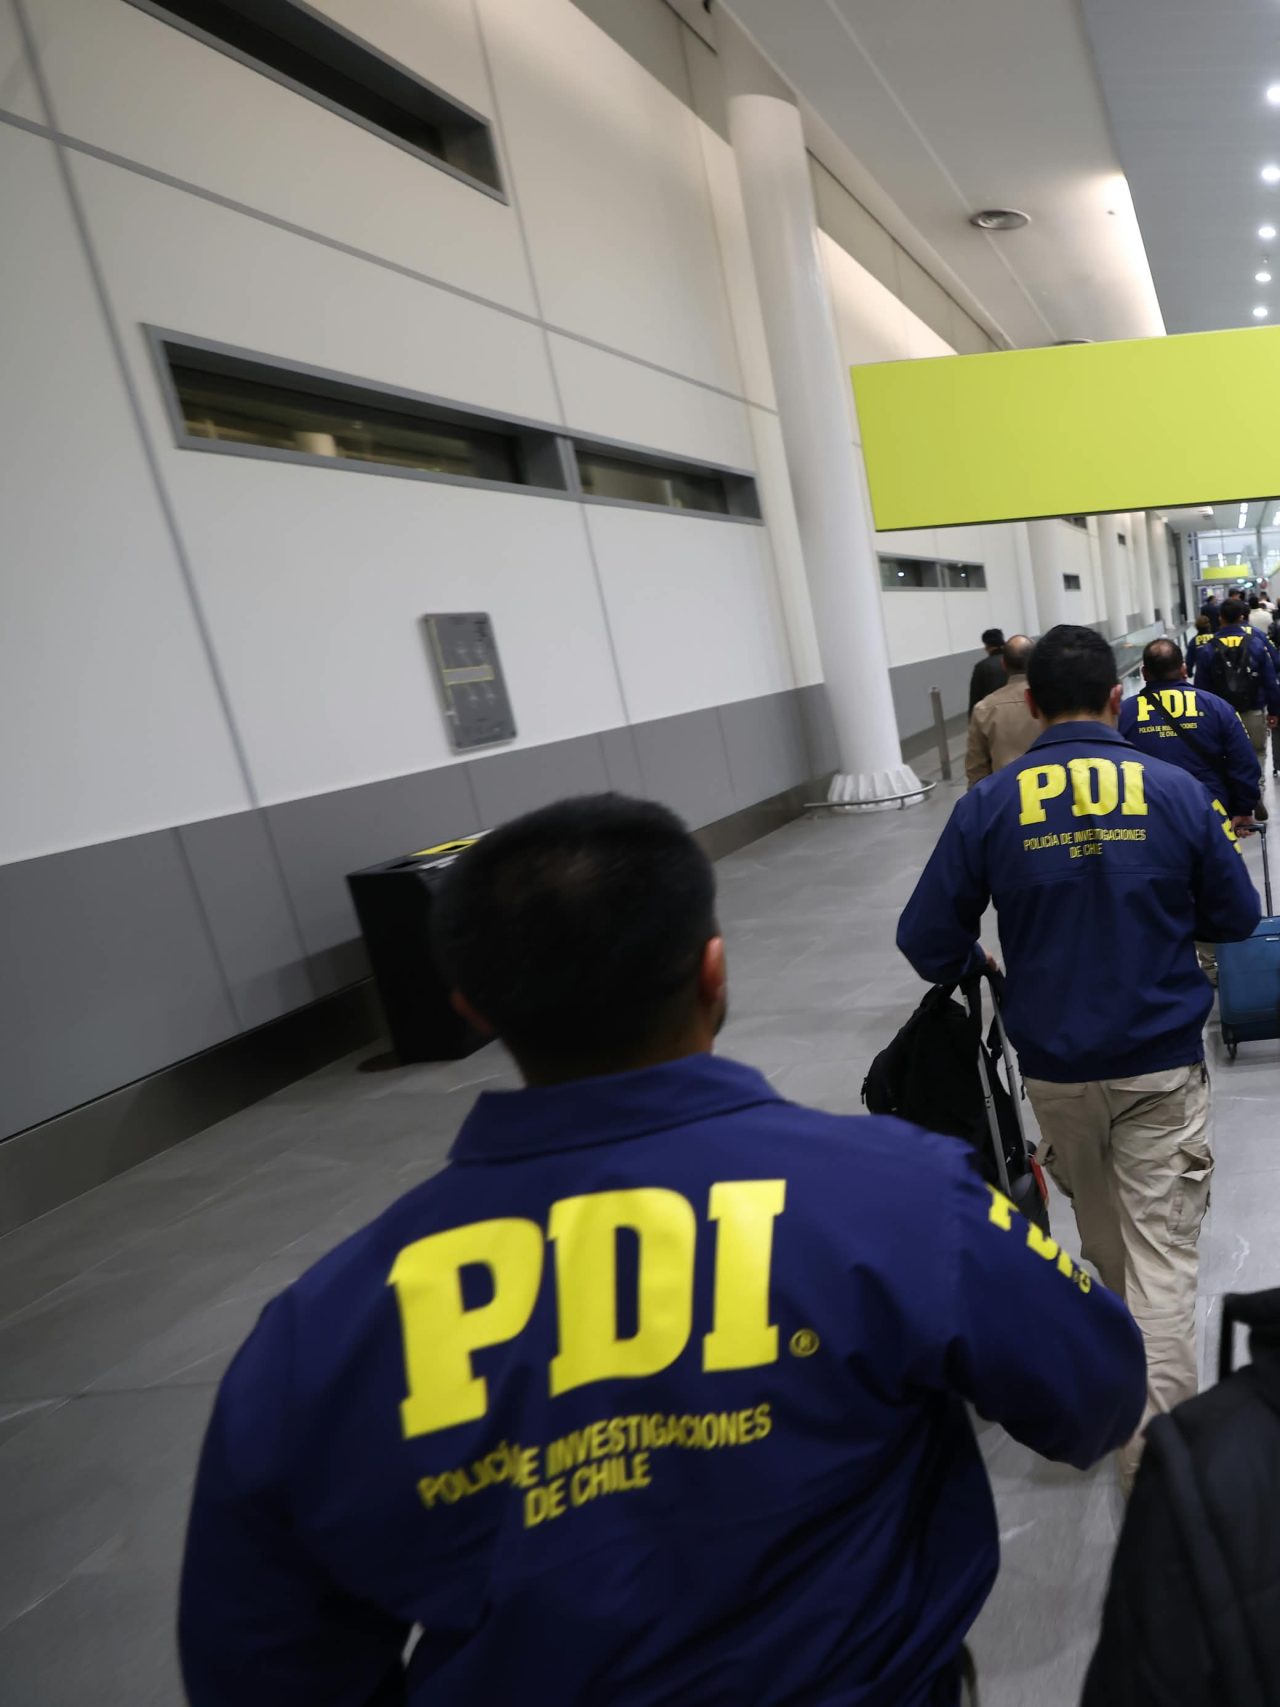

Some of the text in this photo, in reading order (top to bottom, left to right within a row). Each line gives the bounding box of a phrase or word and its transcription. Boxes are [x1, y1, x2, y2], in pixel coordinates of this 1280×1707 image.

[1016, 757, 1148, 826] PDI
[1024, 832, 1060, 851] POLICÍA
[1060, 832, 1073, 845] DE
[1069, 845, 1083, 859] DE
[386, 1179, 787, 1439] PDI
[545, 1403, 773, 1480] INVESTIGACIONES
[524, 1452, 652, 1529] DE CHILE
